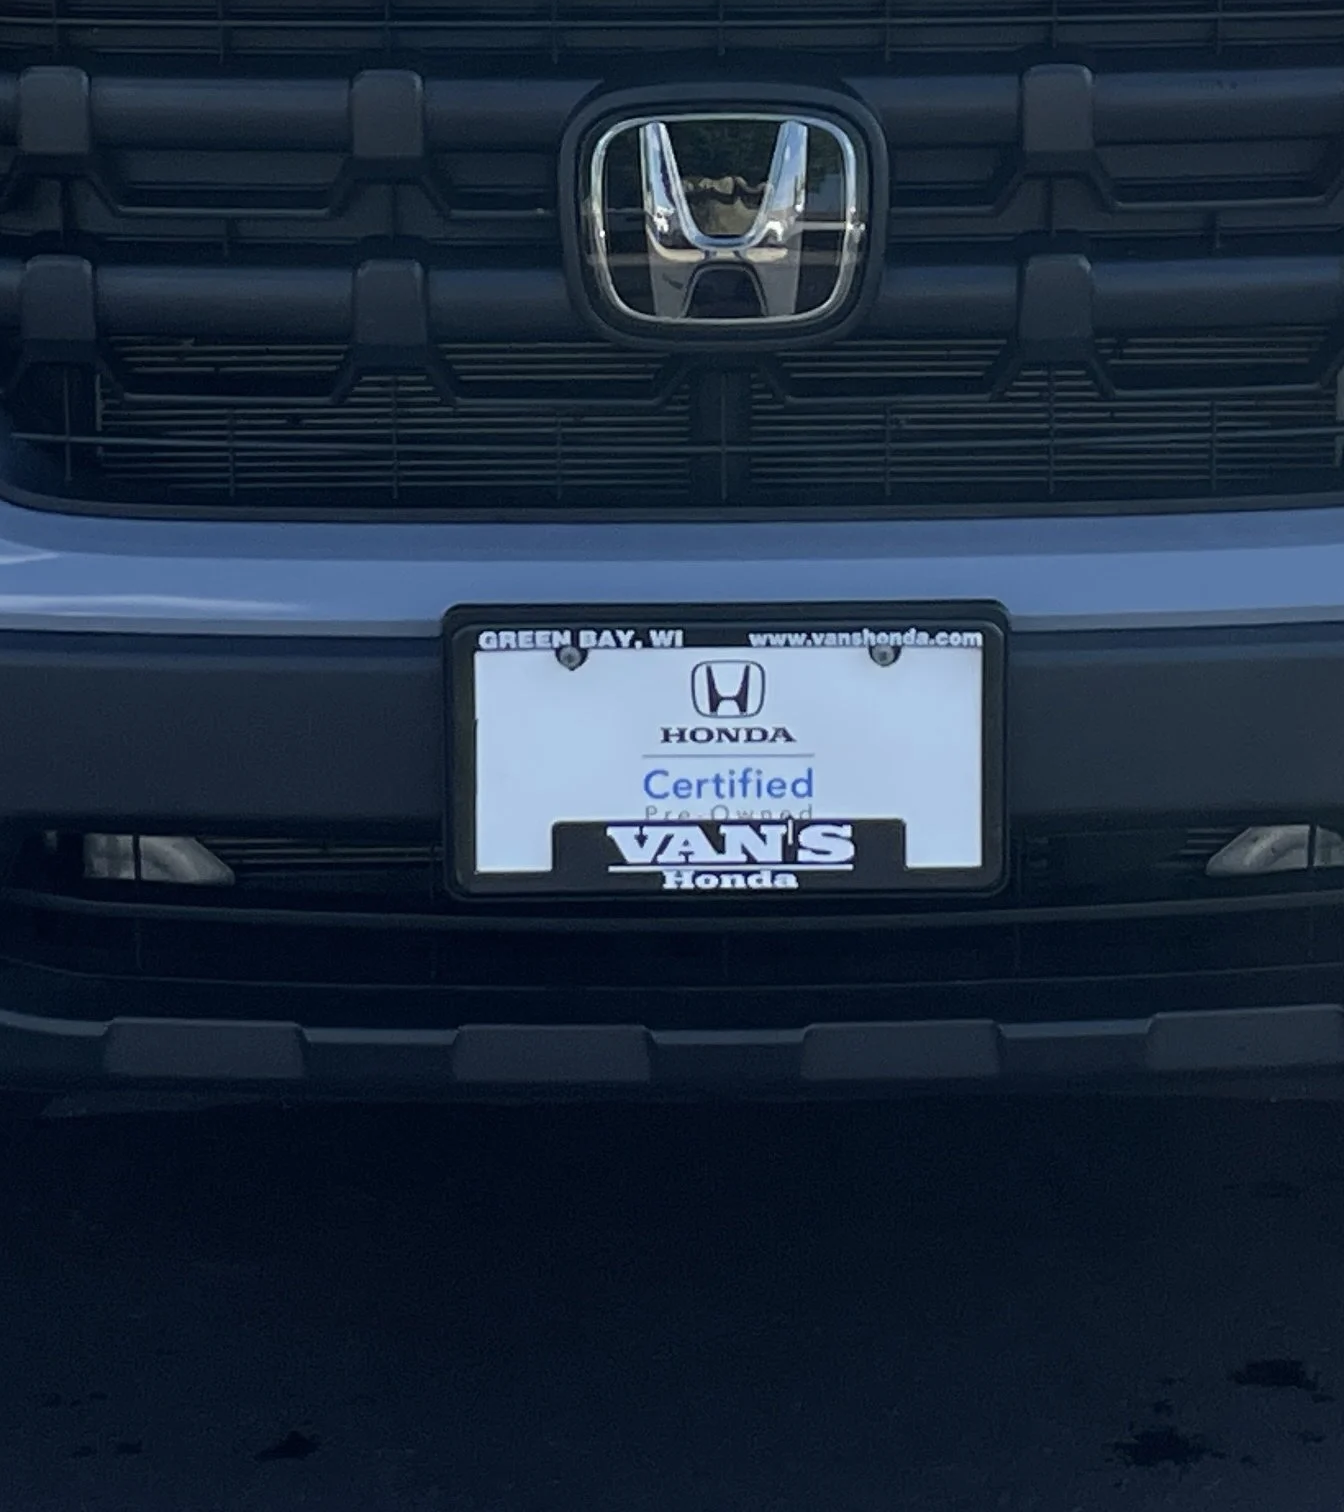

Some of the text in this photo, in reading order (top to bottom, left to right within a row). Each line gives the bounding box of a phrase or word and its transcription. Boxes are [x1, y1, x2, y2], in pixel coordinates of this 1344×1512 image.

[479, 630, 683, 650] GREEN BAY, WI
[749, 629, 983, 647] www.vanshonda.com
[661, 727, 796, 743] HONDA
[643, 768, 814, 799] Certified
[606, 822, 854, 863] VAN'S
[663, 870, 799, 889] Honda
